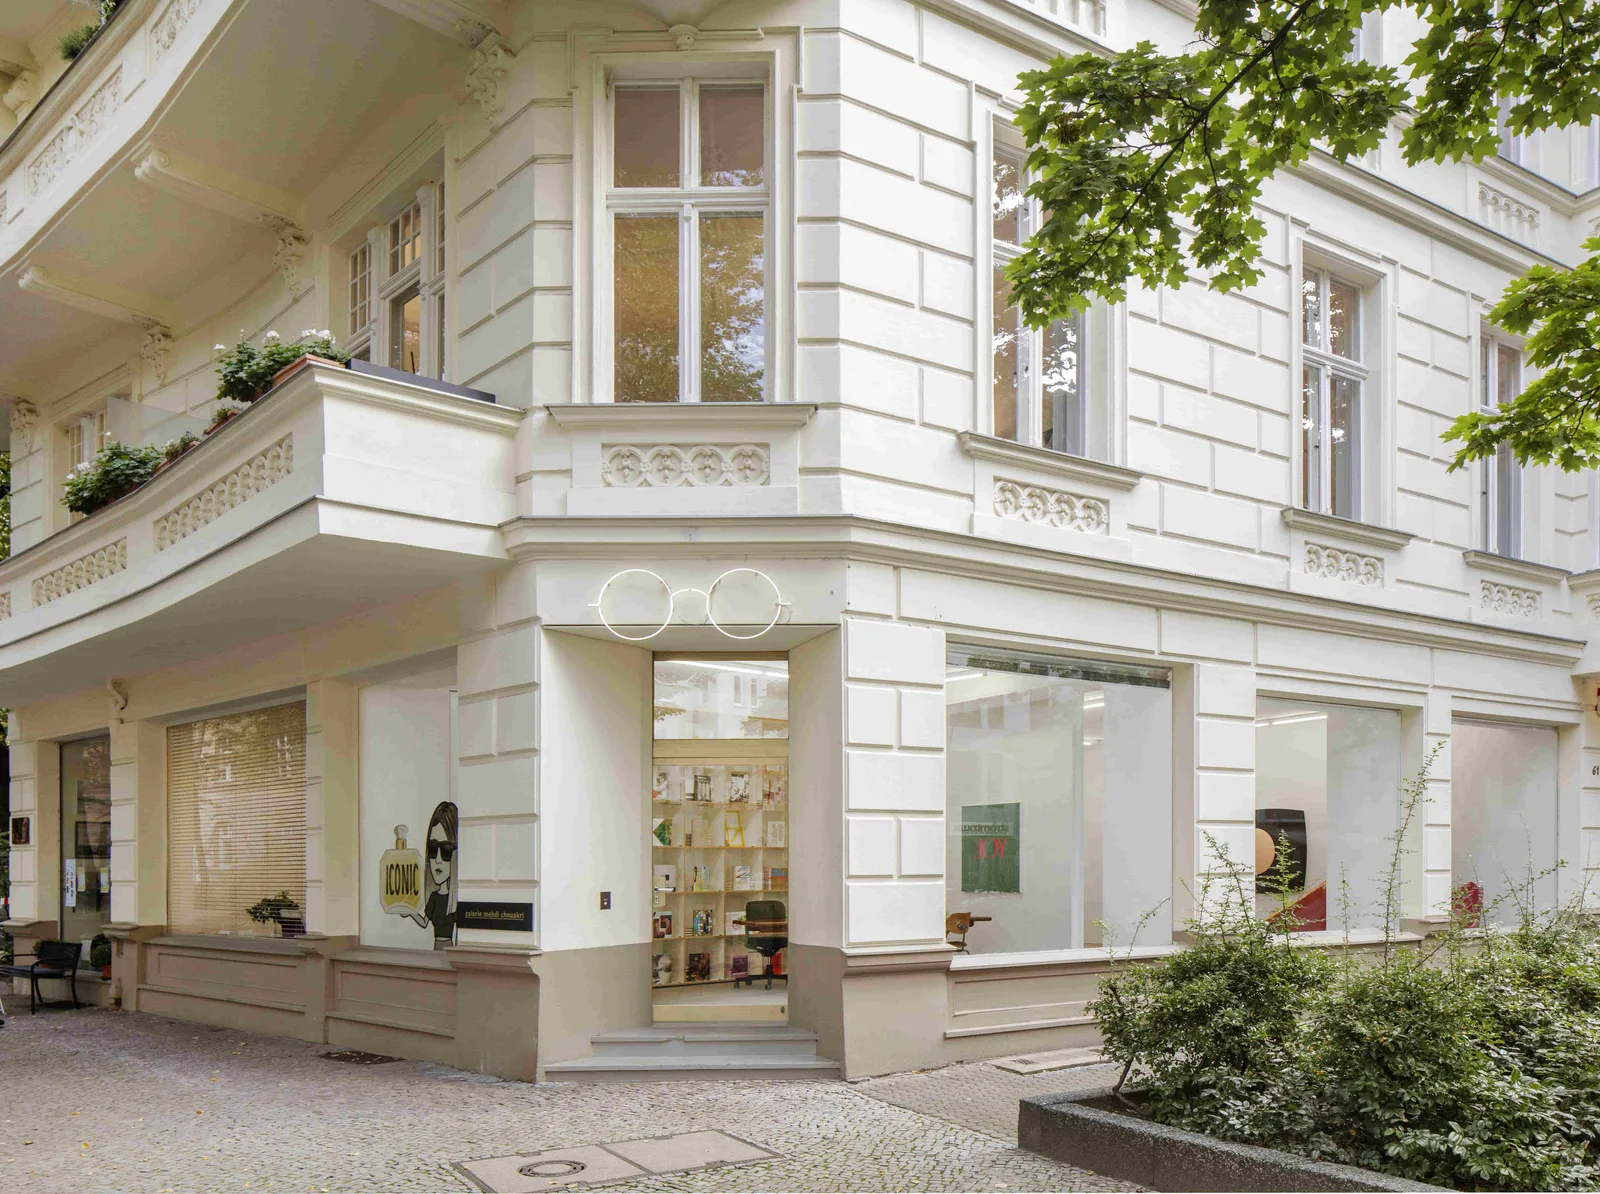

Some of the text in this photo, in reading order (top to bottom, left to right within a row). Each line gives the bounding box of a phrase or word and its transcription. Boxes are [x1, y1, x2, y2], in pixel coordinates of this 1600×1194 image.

[1592, 765, 1600, 776] 61
[385, 863, 419, 896] ICONIC
[465, 910, 482, 918] galerie
[483, 910, 499, 918] mehdi
